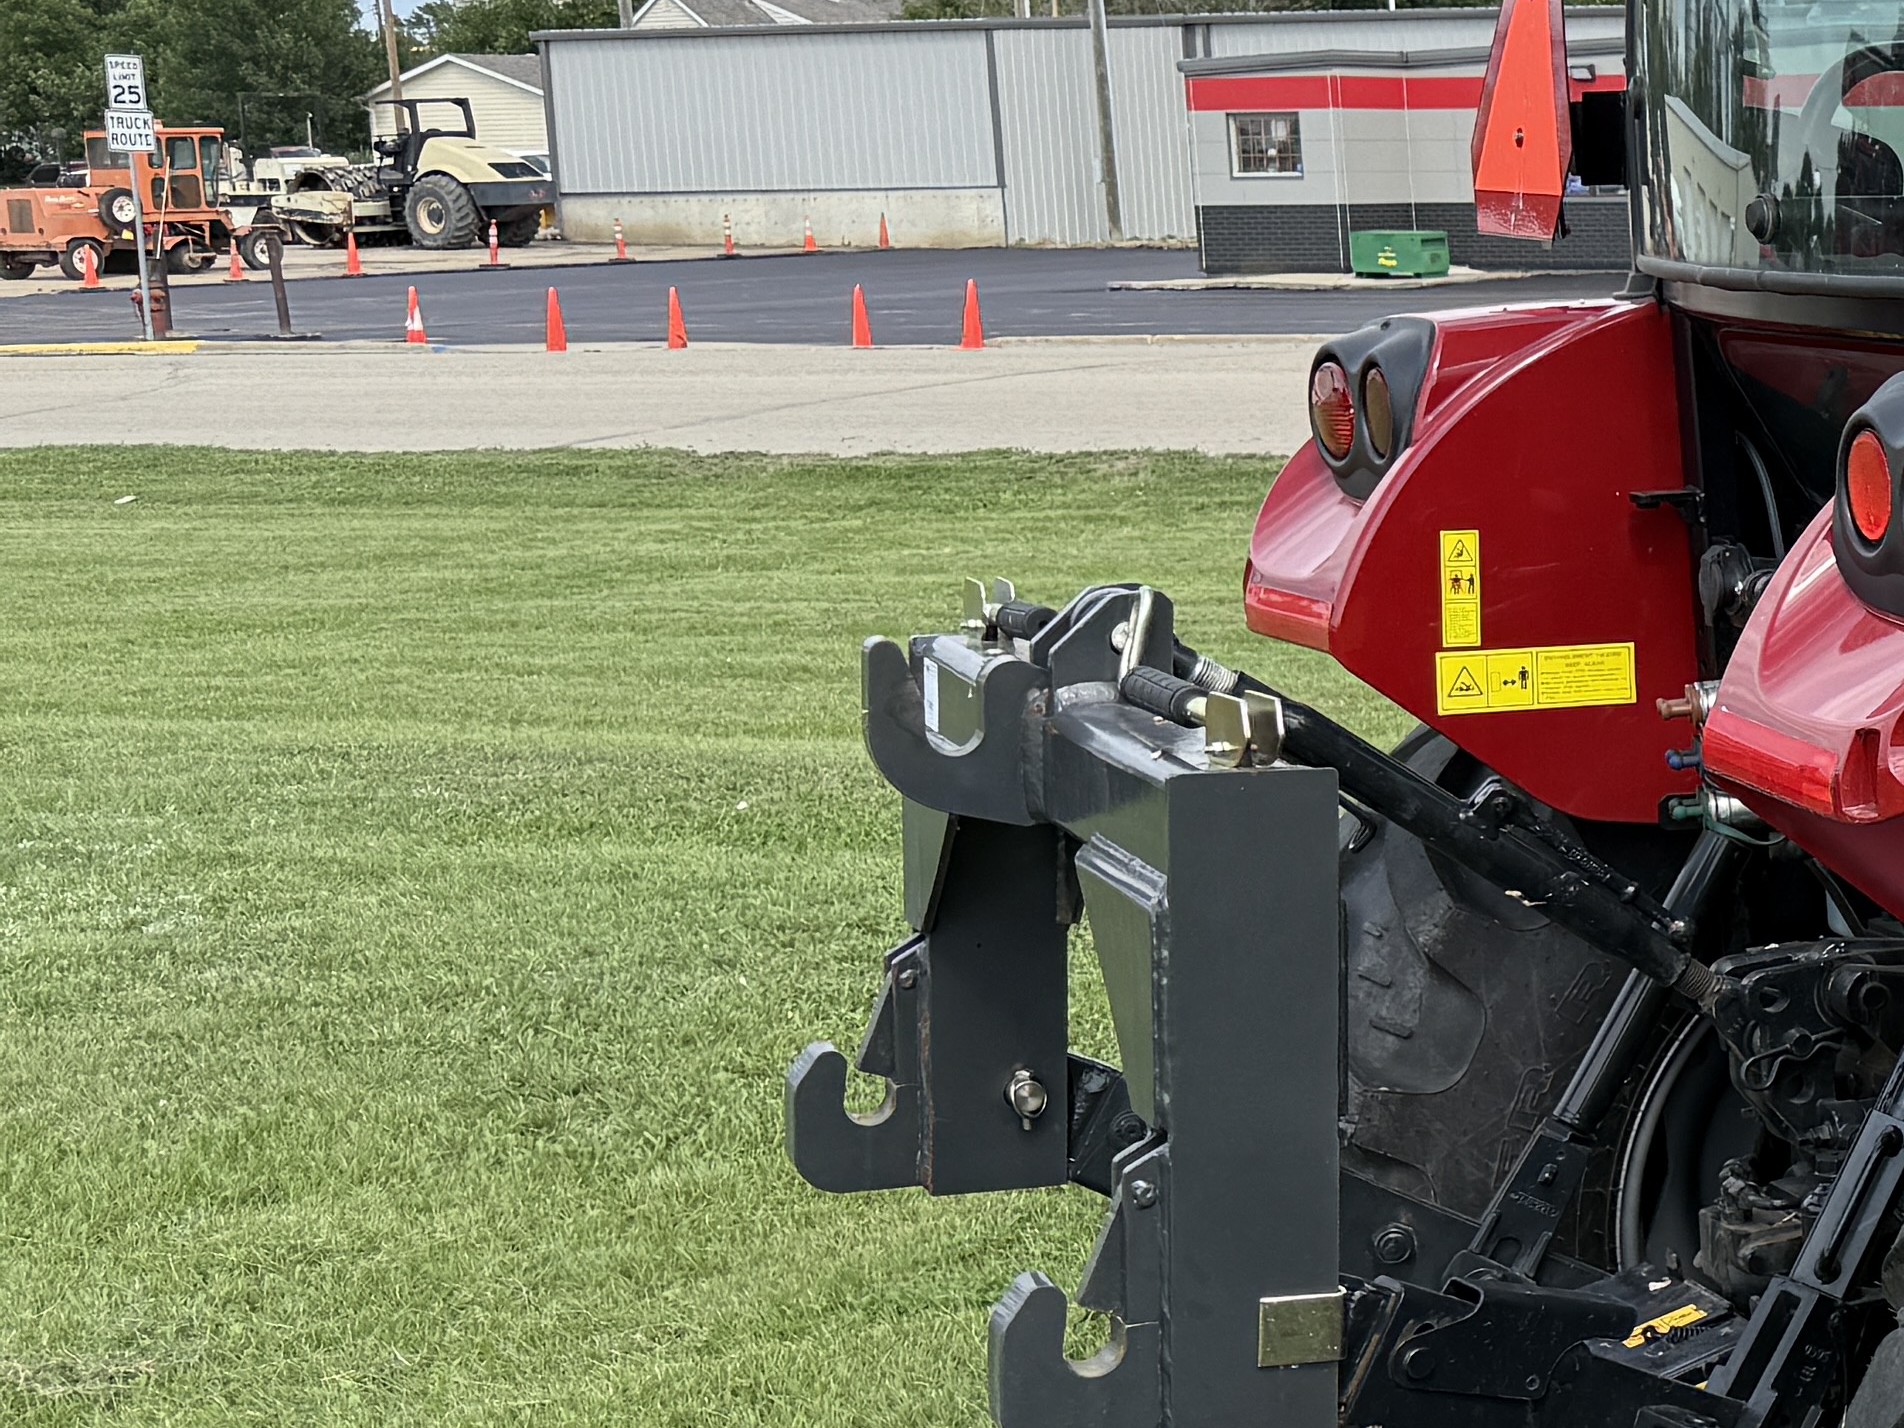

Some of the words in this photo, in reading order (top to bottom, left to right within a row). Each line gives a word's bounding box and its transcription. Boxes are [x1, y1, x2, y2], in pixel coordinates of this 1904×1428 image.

[112, 84, 141, 104] 25
[109, 115, 151, 130] TRUCK
[111, 132, 152, 146] ROUTE
